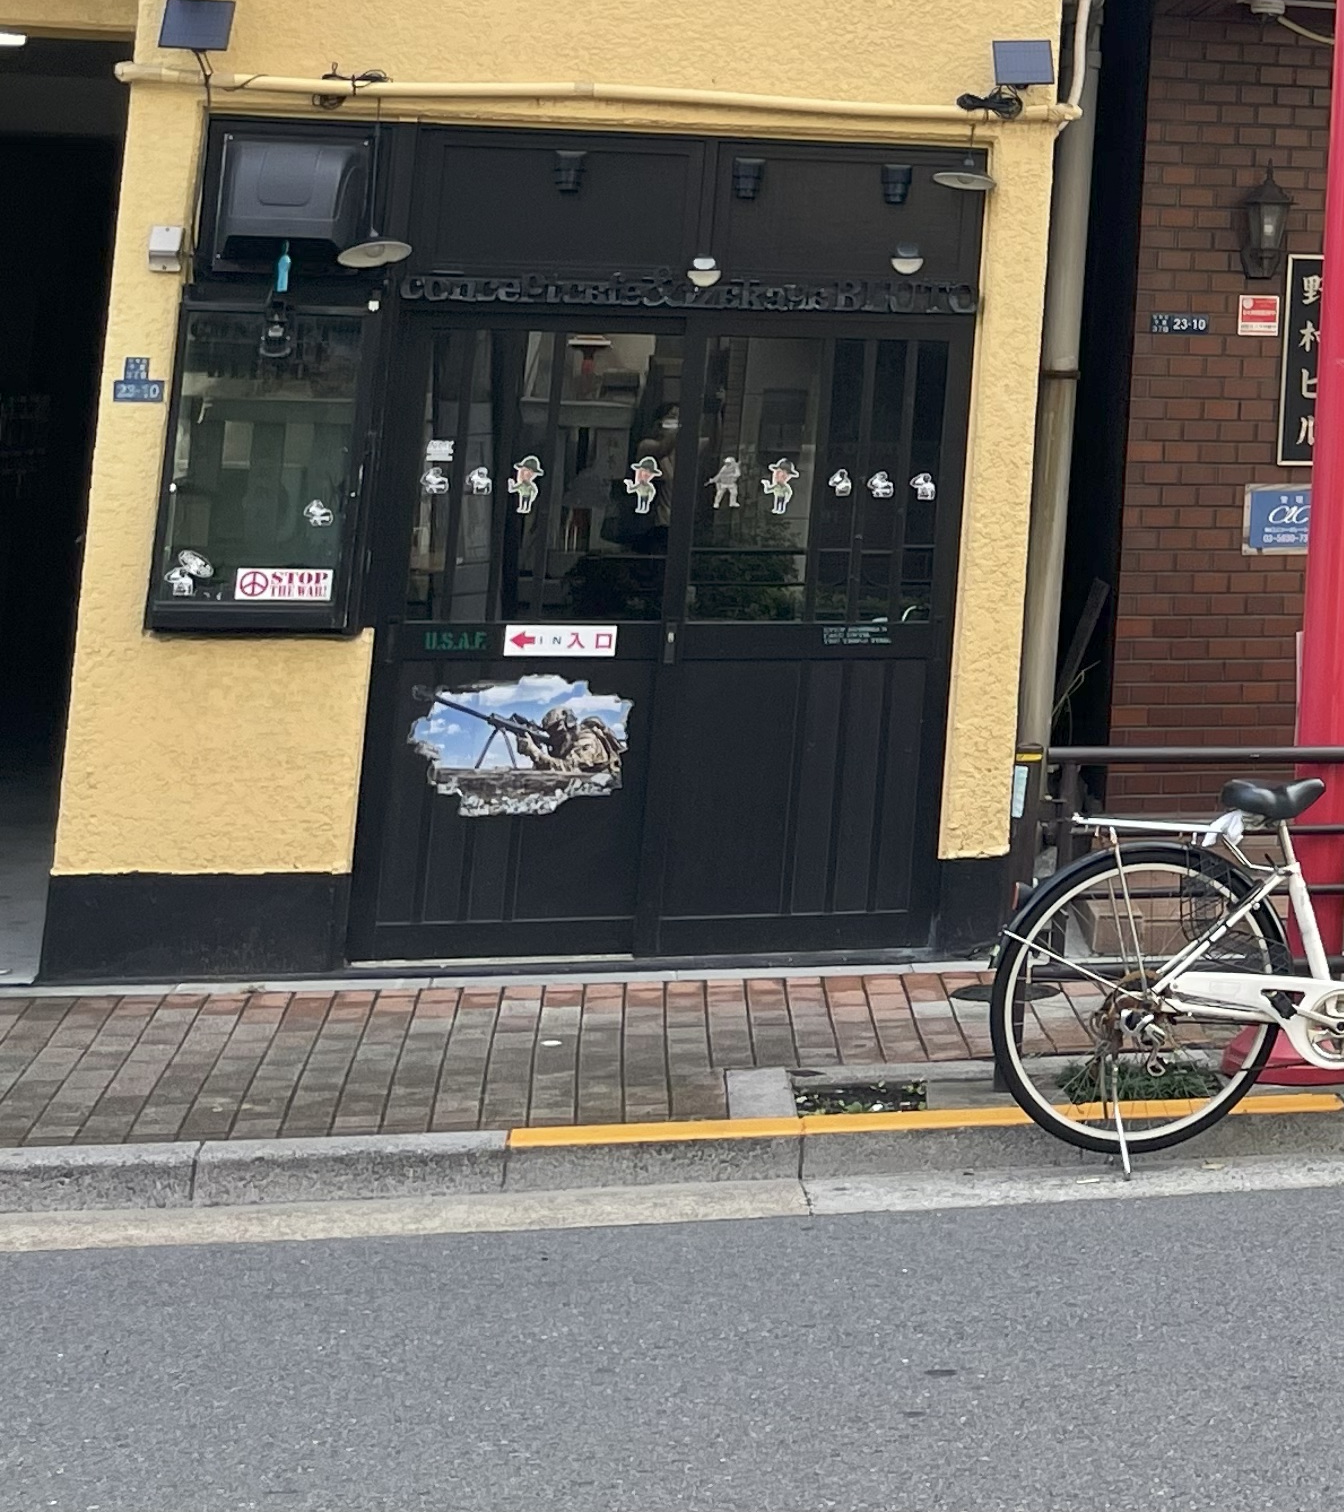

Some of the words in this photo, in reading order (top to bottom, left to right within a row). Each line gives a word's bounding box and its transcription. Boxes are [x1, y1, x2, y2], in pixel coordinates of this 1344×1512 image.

[1173, 317, 1206, 330] 23-10
[271, 571, 329, 586] STOP
[271, 585, 295, 597] THE
[539, 635, 562, 646] IN
[567, 632, 613, 650] 入口
